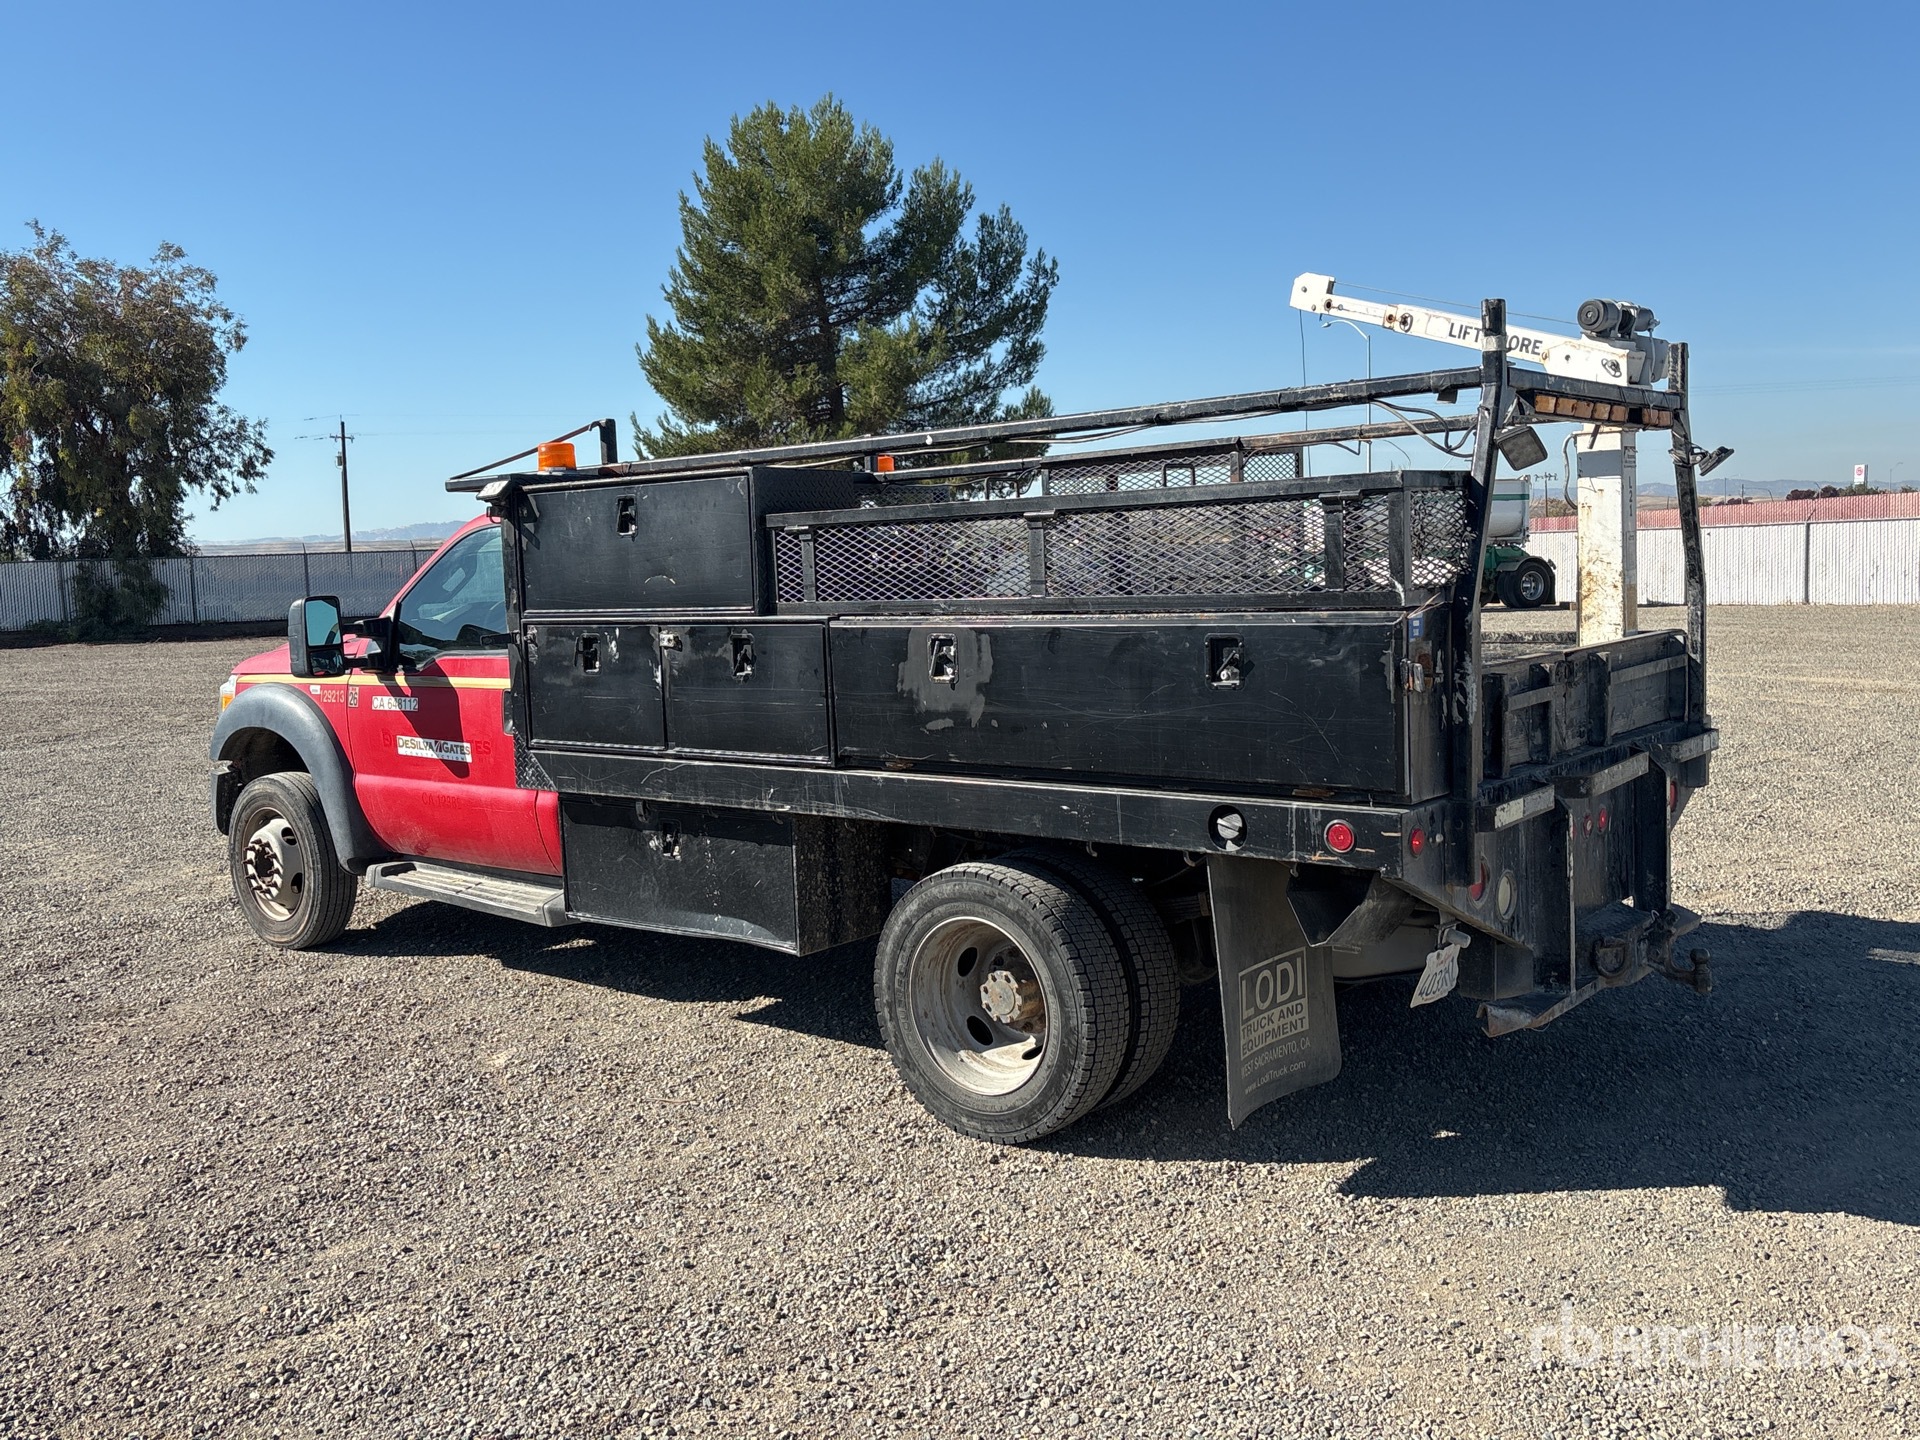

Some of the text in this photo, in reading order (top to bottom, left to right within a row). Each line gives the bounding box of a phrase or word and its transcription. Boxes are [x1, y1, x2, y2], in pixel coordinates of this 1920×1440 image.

[1448, 322, 1543, 356] LIFTORE
[320, 689, 345, 703] 129213
[349, 691, 358, 706] 26
[372, 698, 418, 711] CA 648112
[442, 741, 471, 756] GATES
[1241, 956, 1303, 1021] LODI
[1241, 1002, 1304, 1040] TRUCK AND
[1242, 1016, 1306, 1058] EQUIPMENT
[1300, 1036, 1311, 1050] CA
